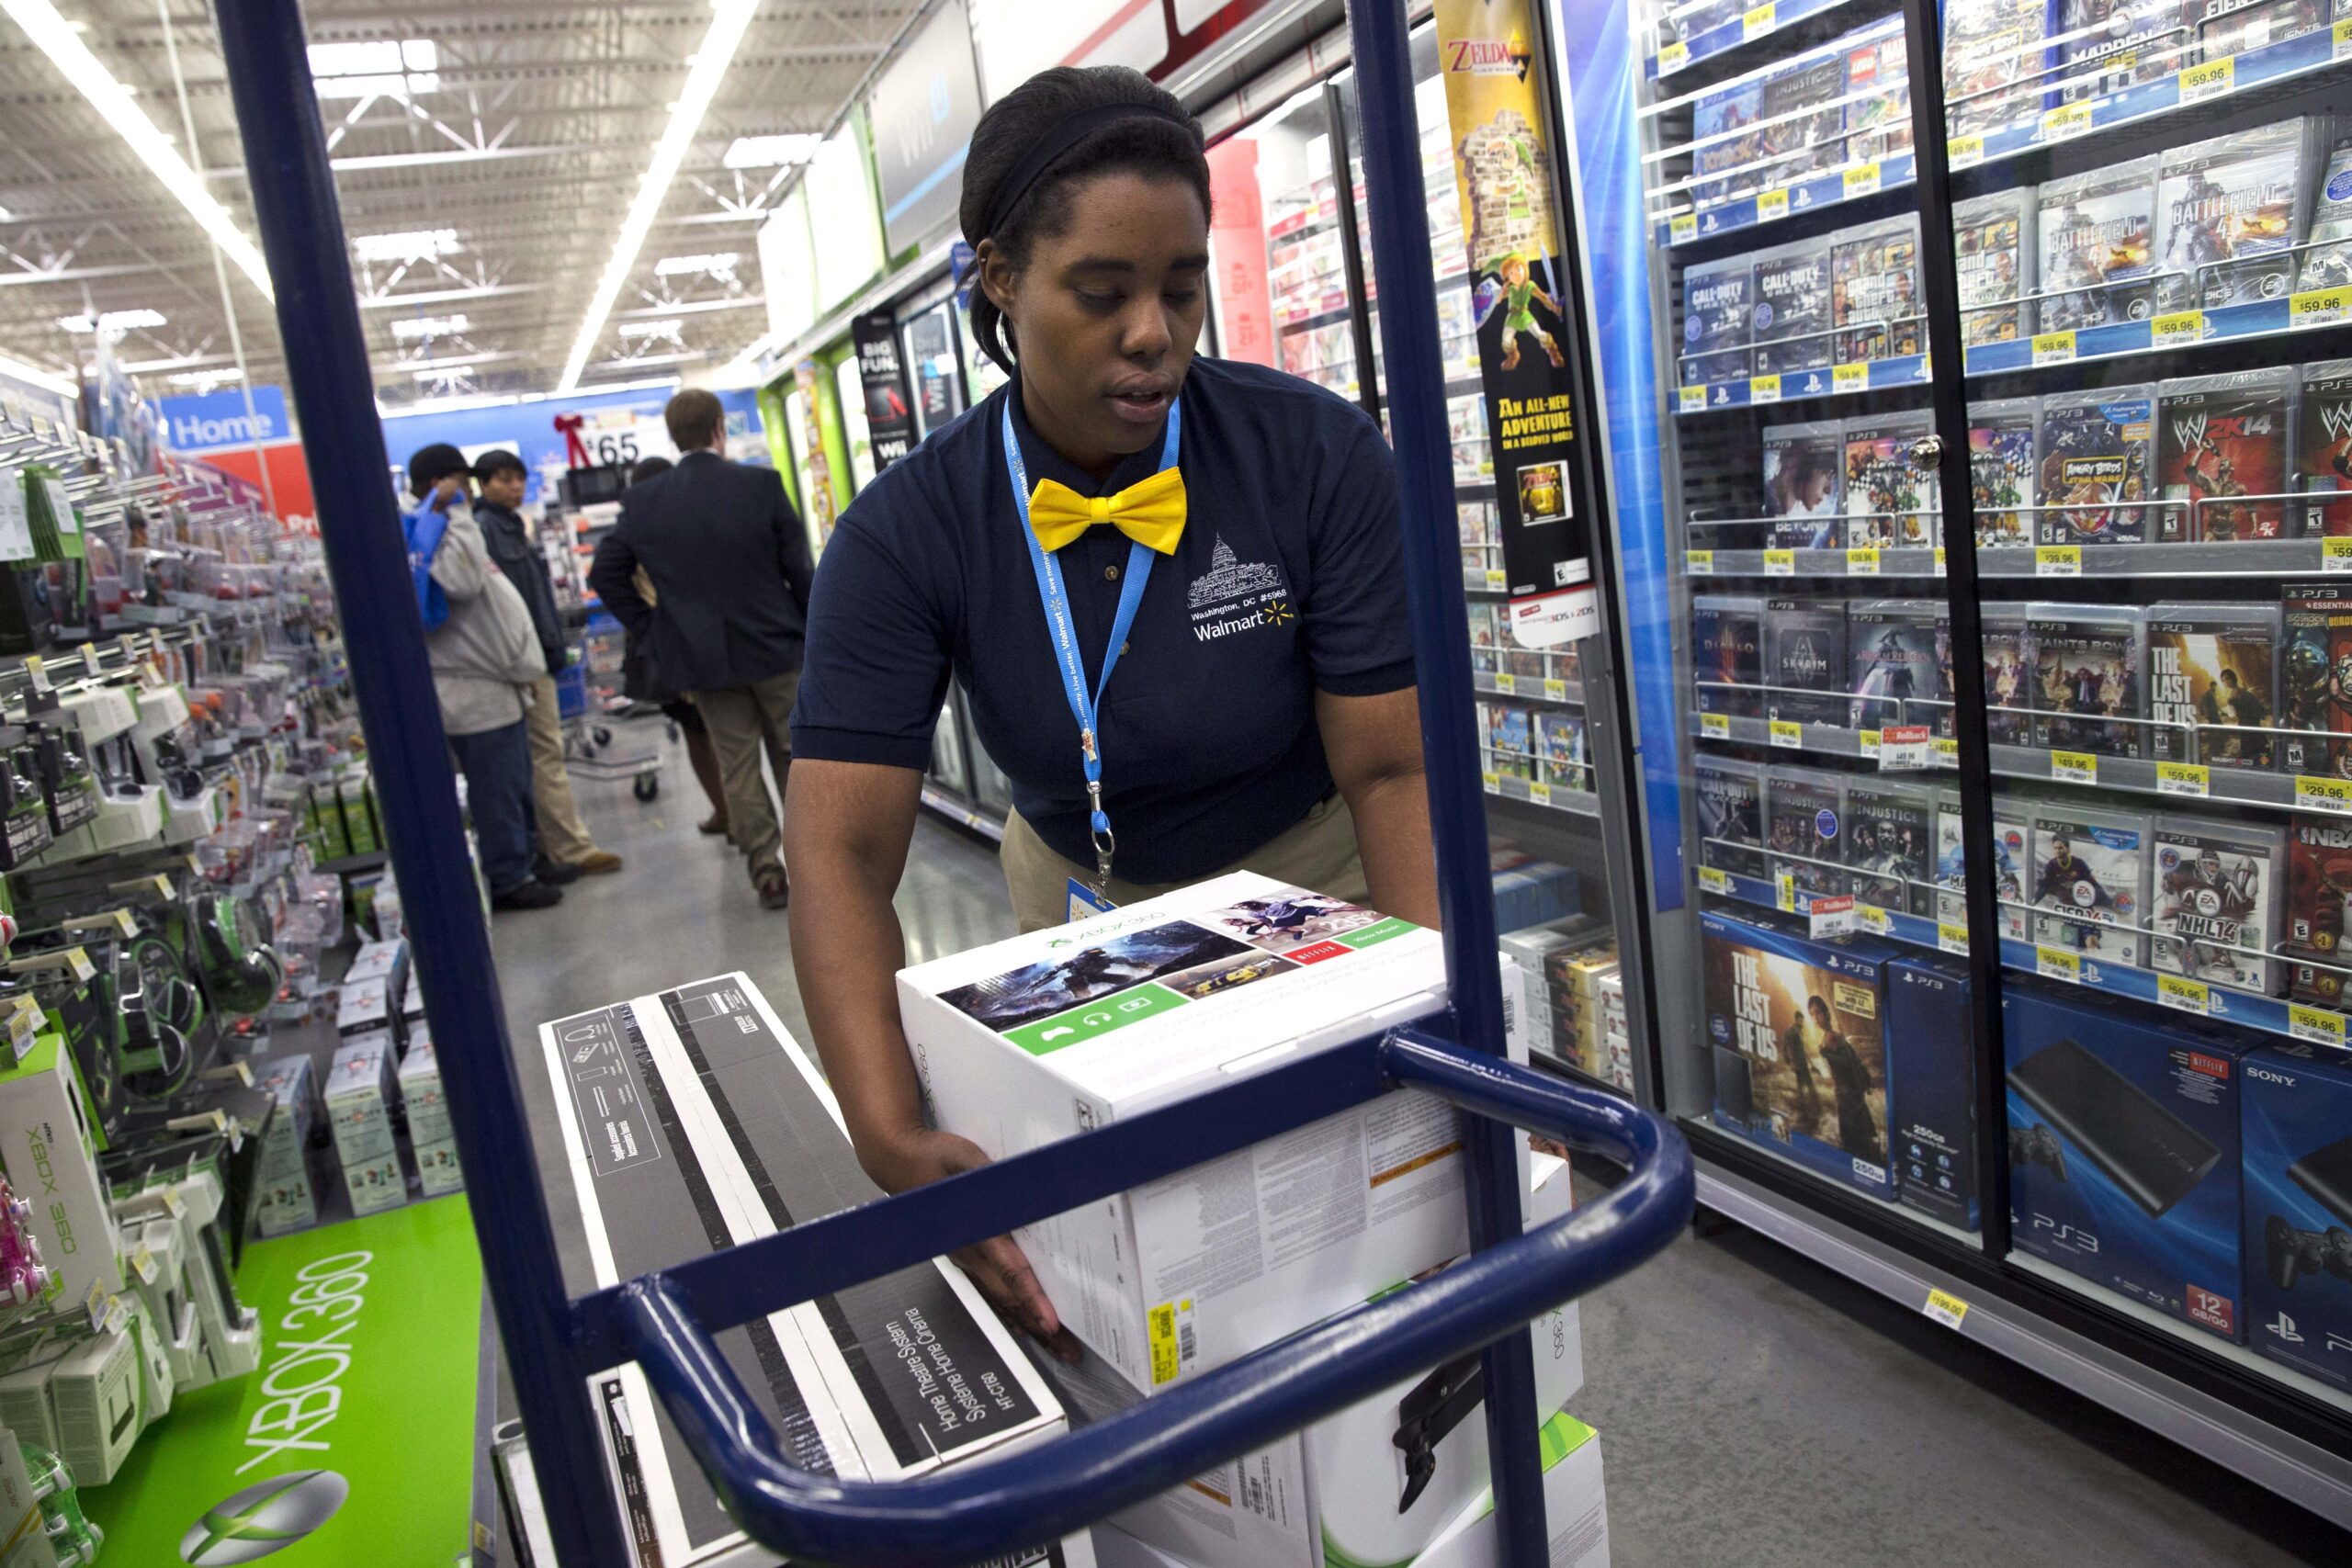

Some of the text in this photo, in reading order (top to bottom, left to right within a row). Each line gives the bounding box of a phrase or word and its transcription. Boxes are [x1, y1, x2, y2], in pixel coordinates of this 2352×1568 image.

[2070, 28, 2153, 63] MADDEN
[1448, 40, 1513, 73] ZELDA
[2188, 68, 2224, 87] $59.96
[2176, 159, 2210, 175] PS3
[2172, 183, 2278, 227] BATTLEFIELD
[2050, 215, 2139, 254] BATTLEFIELD
[2215, 219, 2227, 240] 4
[1956, 253, 1985, 272] and
[2088, 244, 2102, 267] 4
[2299, 298, 2340, 314] $59.96
[2160, 320, 2194, 335] $59.96
[862, 341, 891, 358] BIG
[2039, 340, 2069, 354] $59.96
[1498, 394, 1570, 418] AN ALL-NEW
[2172, 395, 2204, 405] PS3
[2057, 409, 2084, 419] PS3
[174, 412, 274, 446] Home
[1501, 411, 1572, 438] ADVENTURE
[2205, 413, 2272, 440] 2K14
[1513, 439, 1521, 449] A
[1521, 434, 1551, 447] BELOVED
[1551, 430, 1574, 445] WORLD
[2066, 461, 2121, 477] ANGRY BIRDS
[2045, 553, 2074, 564] $39.96
[1049, 578, 1057, 595] Save
[2302, 590, 2338, 599] PS3
[1191, 603, 1240, 622] Washington,
[1243, 597, 1257, 607] DC
[2312, 602, 2352, 610] ESSENTIA
[1055, 611, 1070, 650] Walmart
[1193, 610, 1265, 641] Walmart
[2040, 623, 2067, 632] PS3
[2162, 624, 2193, 633] PS3
[1782, 658, 1827, 671] SKYRIM
[2152, 647, 2181, 675] THE
[2152, 674, 2192, 704] LAST
[2174, 704, 2197, 732] US
[1895, 729, 1927, 740] Rollback
[2058, 758, 2087, 770] $49.96
[2167, 770, 2201, 784] $59.96
[2304, 784, 2344, 799] $29.96
[1857, 805, 1918, 823] INJUSTICE
[2045, 822, 2075, 833] PS3
[2169, 834, 2199, 846] PS3
[2310, 829, 2352, 848] NBA
[1296, 945, 1337, 961] NETFLIX
[1732, 952, 1760, 990] THE
[1844, 960, 1875, 977] PS3
[1917, 976, 1944, 990] PS3
[2168, 985, 2200, 1000] $59.96
[1734, 985, 1771, 1026] LAST
[2298, 1015, 2336, 1032] $59.96
[1736, 1017, 1756, 1053] OF
[1756, 1025, 1779, 1063] US
[2193, 1057, 2224, 1073] NETFLIX
[2247, 1066, 2296, 1088] SONY
[1913, 1123, 1946, 1145] 250GB
[1854, 1161, 1885, 1182] 250GB
[26, 1126, 77, 1256] XBOX 360
[2032, 1212, 2100, 1254] PS3
[2198, 1295, 2222, 1316] 12
[2192, 1308, 2229, 1329] GB/GO
[1553, 1319, 1565, 1359] 360
[235, 1249, 374, 1476] XBOX 360
[927, 1344, 956, 1377] Home
[886, 1321, 961, 1433] Home Theatre System
[947, 1373, 986, 1423] Système
[980, 1371, 1015, 1411] HT-CT60
